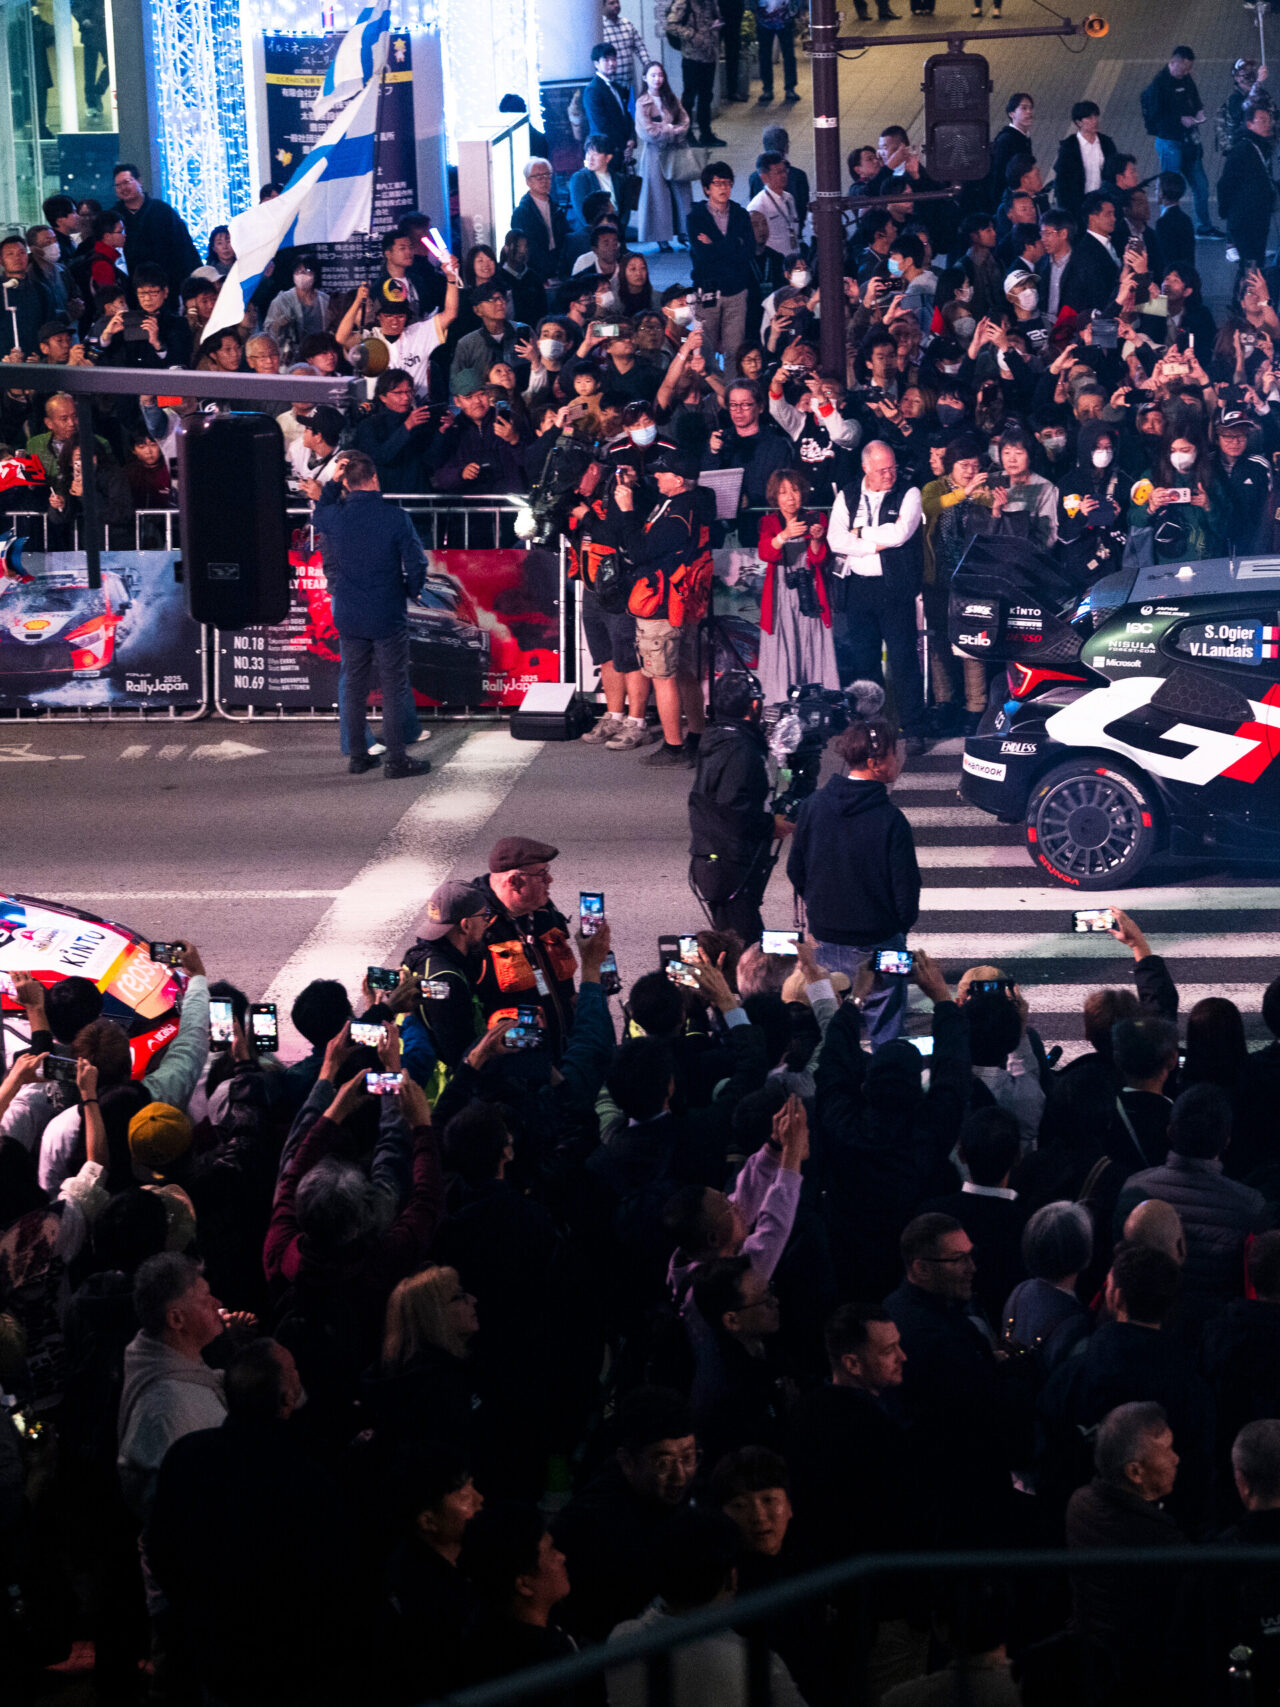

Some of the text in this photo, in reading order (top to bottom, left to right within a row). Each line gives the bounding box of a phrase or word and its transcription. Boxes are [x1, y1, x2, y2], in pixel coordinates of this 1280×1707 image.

[1204, 625, 1256, 642] S.Ogier
[233, 636, 265, 651] NO.18
[1190, 642, 1254, 658] V.Landais
[233, 656, 265, 670] NO.33
[233, 675, 265, 690] NO.69
[482, 678, 529, 695] RallyJap
[1001, 742, 1038, 753] ENDLESS
